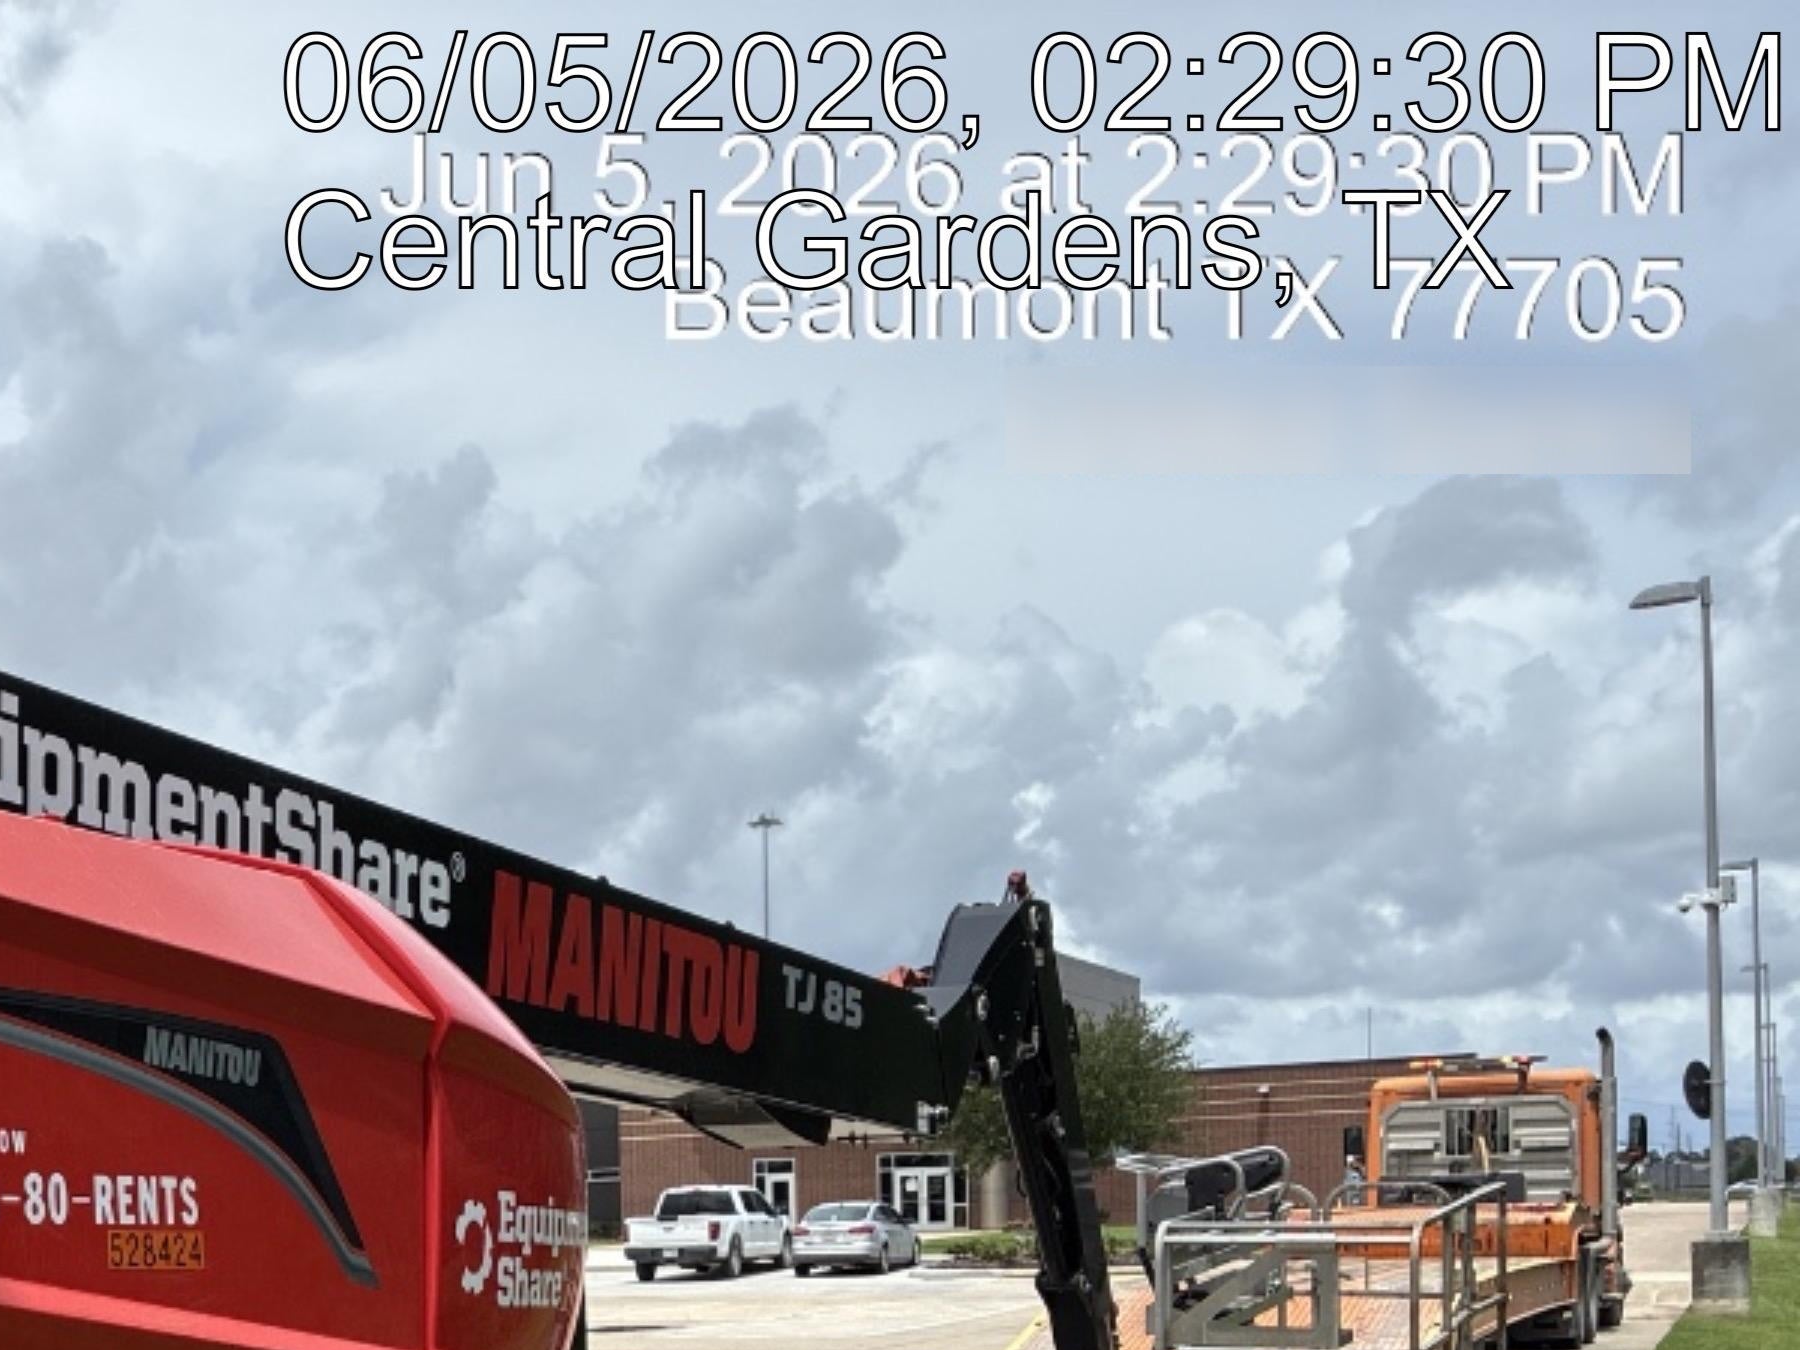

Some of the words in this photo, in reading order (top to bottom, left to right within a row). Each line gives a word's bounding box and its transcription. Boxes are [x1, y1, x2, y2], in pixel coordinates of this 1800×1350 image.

[488, 869, 760, 1055] MANITOU
[782, 964, 818, 1015] TJ
[822, 980, 864, 1030] 85
[143, 1025, 261, 1087] MANITOU
[111, 1232, 202, 1268] 528424
[497, 1256, 562, 1308] Share
